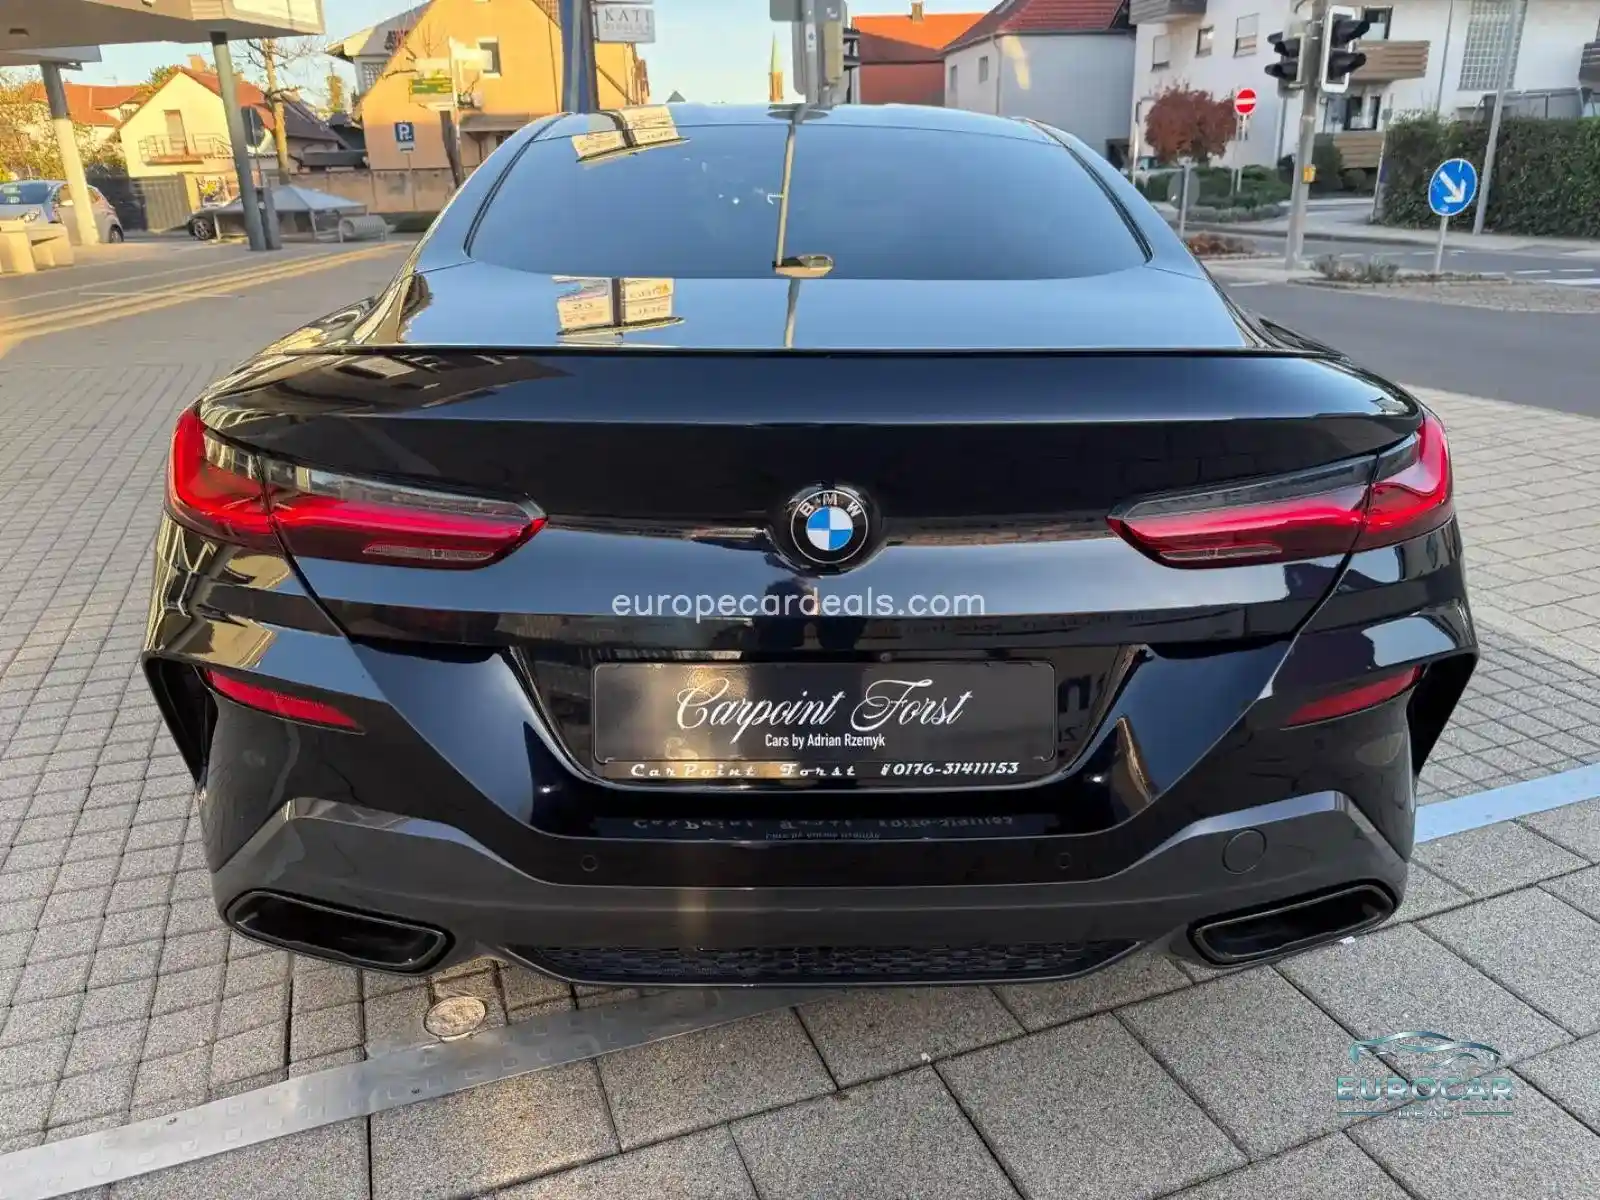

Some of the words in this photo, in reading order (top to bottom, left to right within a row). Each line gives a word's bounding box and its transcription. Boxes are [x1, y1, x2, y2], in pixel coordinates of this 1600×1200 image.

[799, 493, 862, 518] BMW
[676, 676, 846, 745] Carpoint
[850, 678, 974, 732] Forst
[765, 733, 789, 747] Cars
[792, 733, 805, 750] by
[807, 732, 842, 747] Adrian
[845, 732, 886, 750] Rzemyk
[631, 763, 755, 777] CarPoint
[779, 763, 856, 777] Forst
